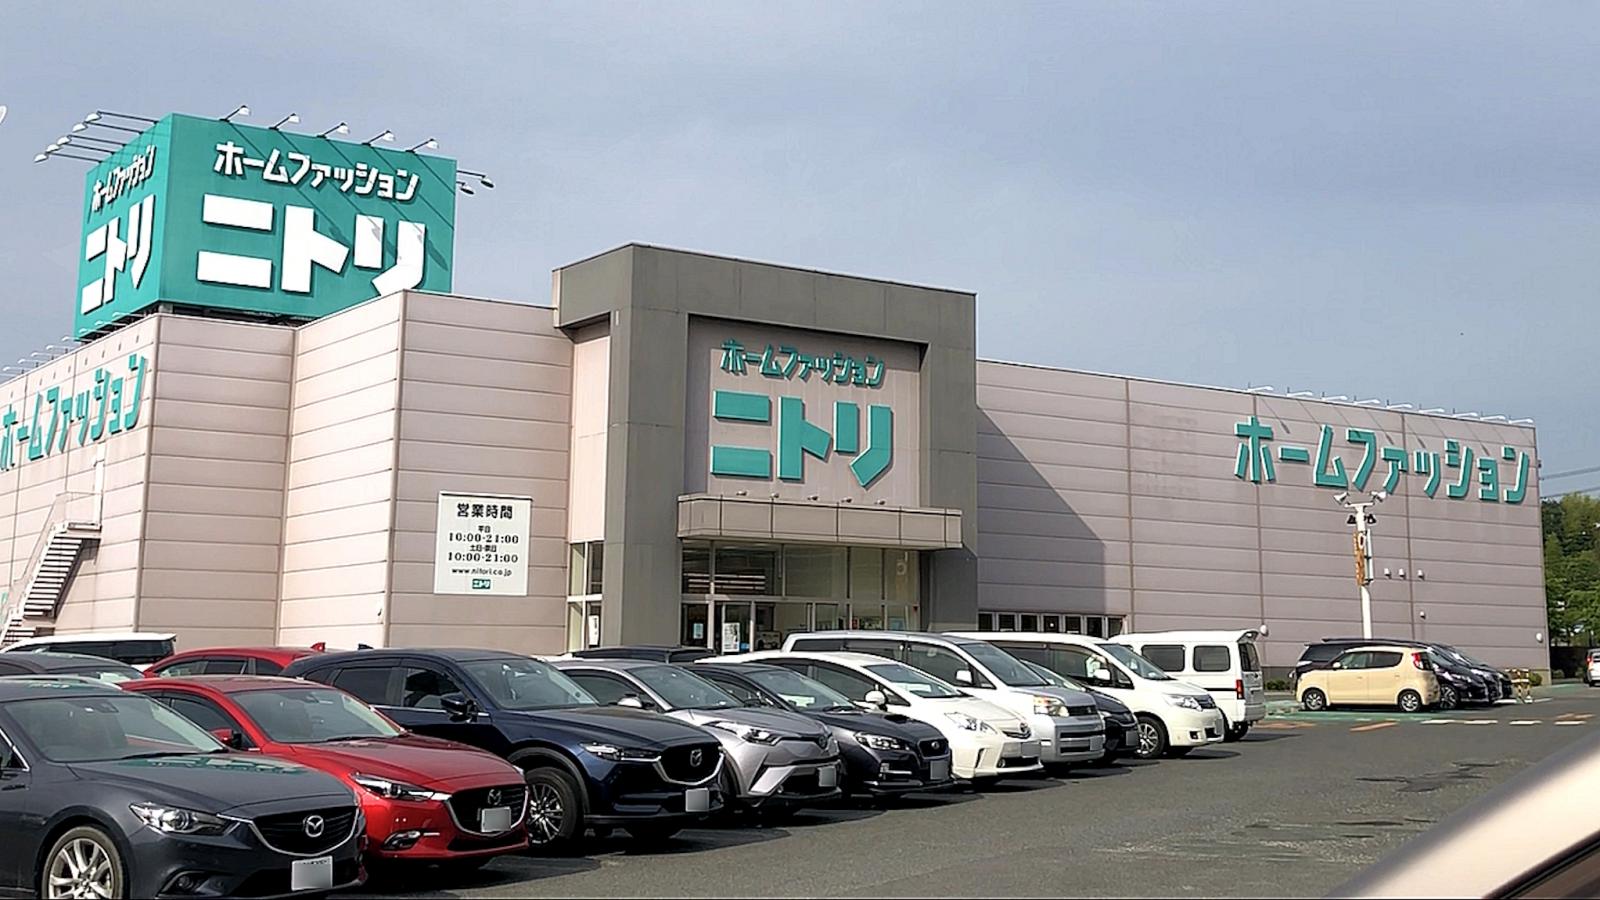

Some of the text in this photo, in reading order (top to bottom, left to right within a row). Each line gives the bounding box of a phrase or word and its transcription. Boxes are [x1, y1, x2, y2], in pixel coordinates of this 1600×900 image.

[92, 144, 156, 212] ホームファッション
[214, 141, 419, 201] ホームファッション
[81, 193, 155, 315] ニトリ
[197, 193, 426, 297] ニトリ
[720, 339, 885, 387] ホームファッション
[0, 353, 147, 471] ホームファッション
[710, 390, 893, 488] ニトリ
[1234, 416, 1530, 503] ホームファッション
[457, 503, 513, 519] 営業時間
